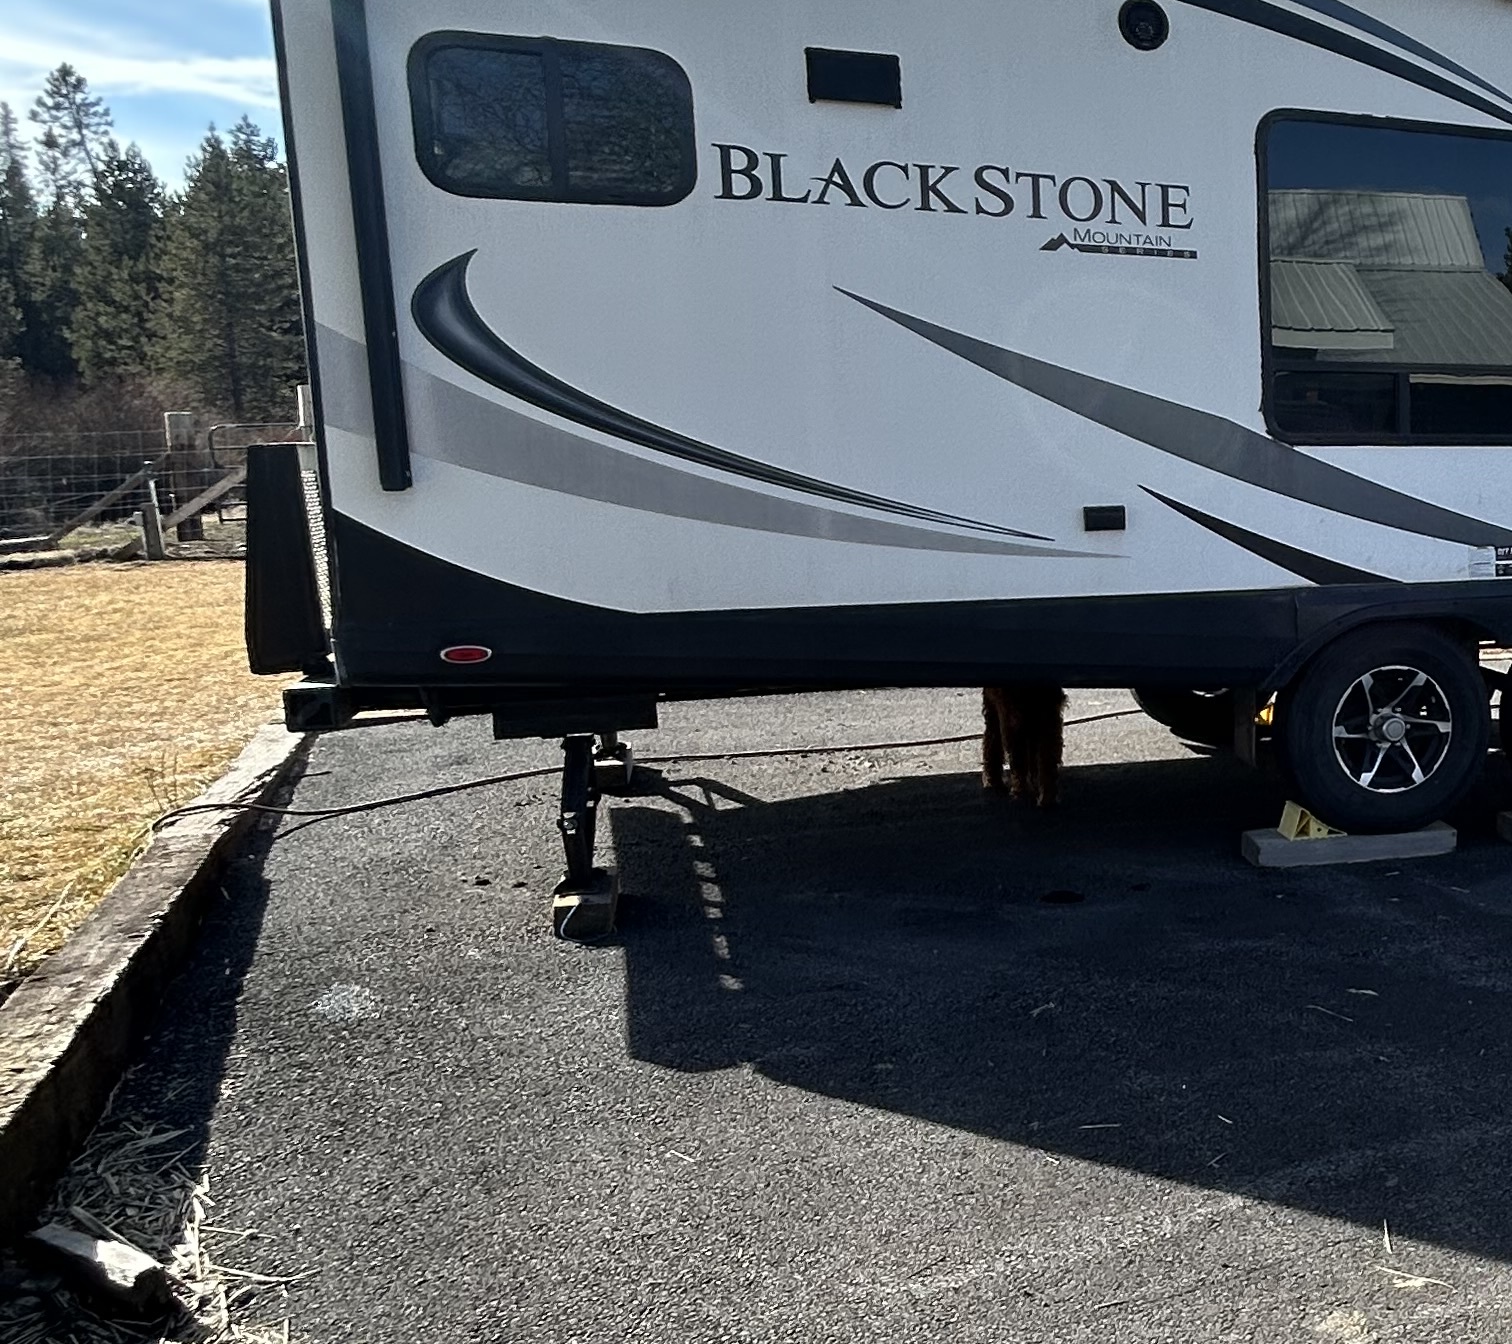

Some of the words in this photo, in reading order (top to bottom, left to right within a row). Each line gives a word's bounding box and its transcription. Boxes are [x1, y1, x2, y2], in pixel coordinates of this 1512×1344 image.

[712, 143, 1194, 229] BLACKSTONE
[1073, 227, 1172, 247] MOUNTAIN
[1101, 246, 1191, 258] SERIES
